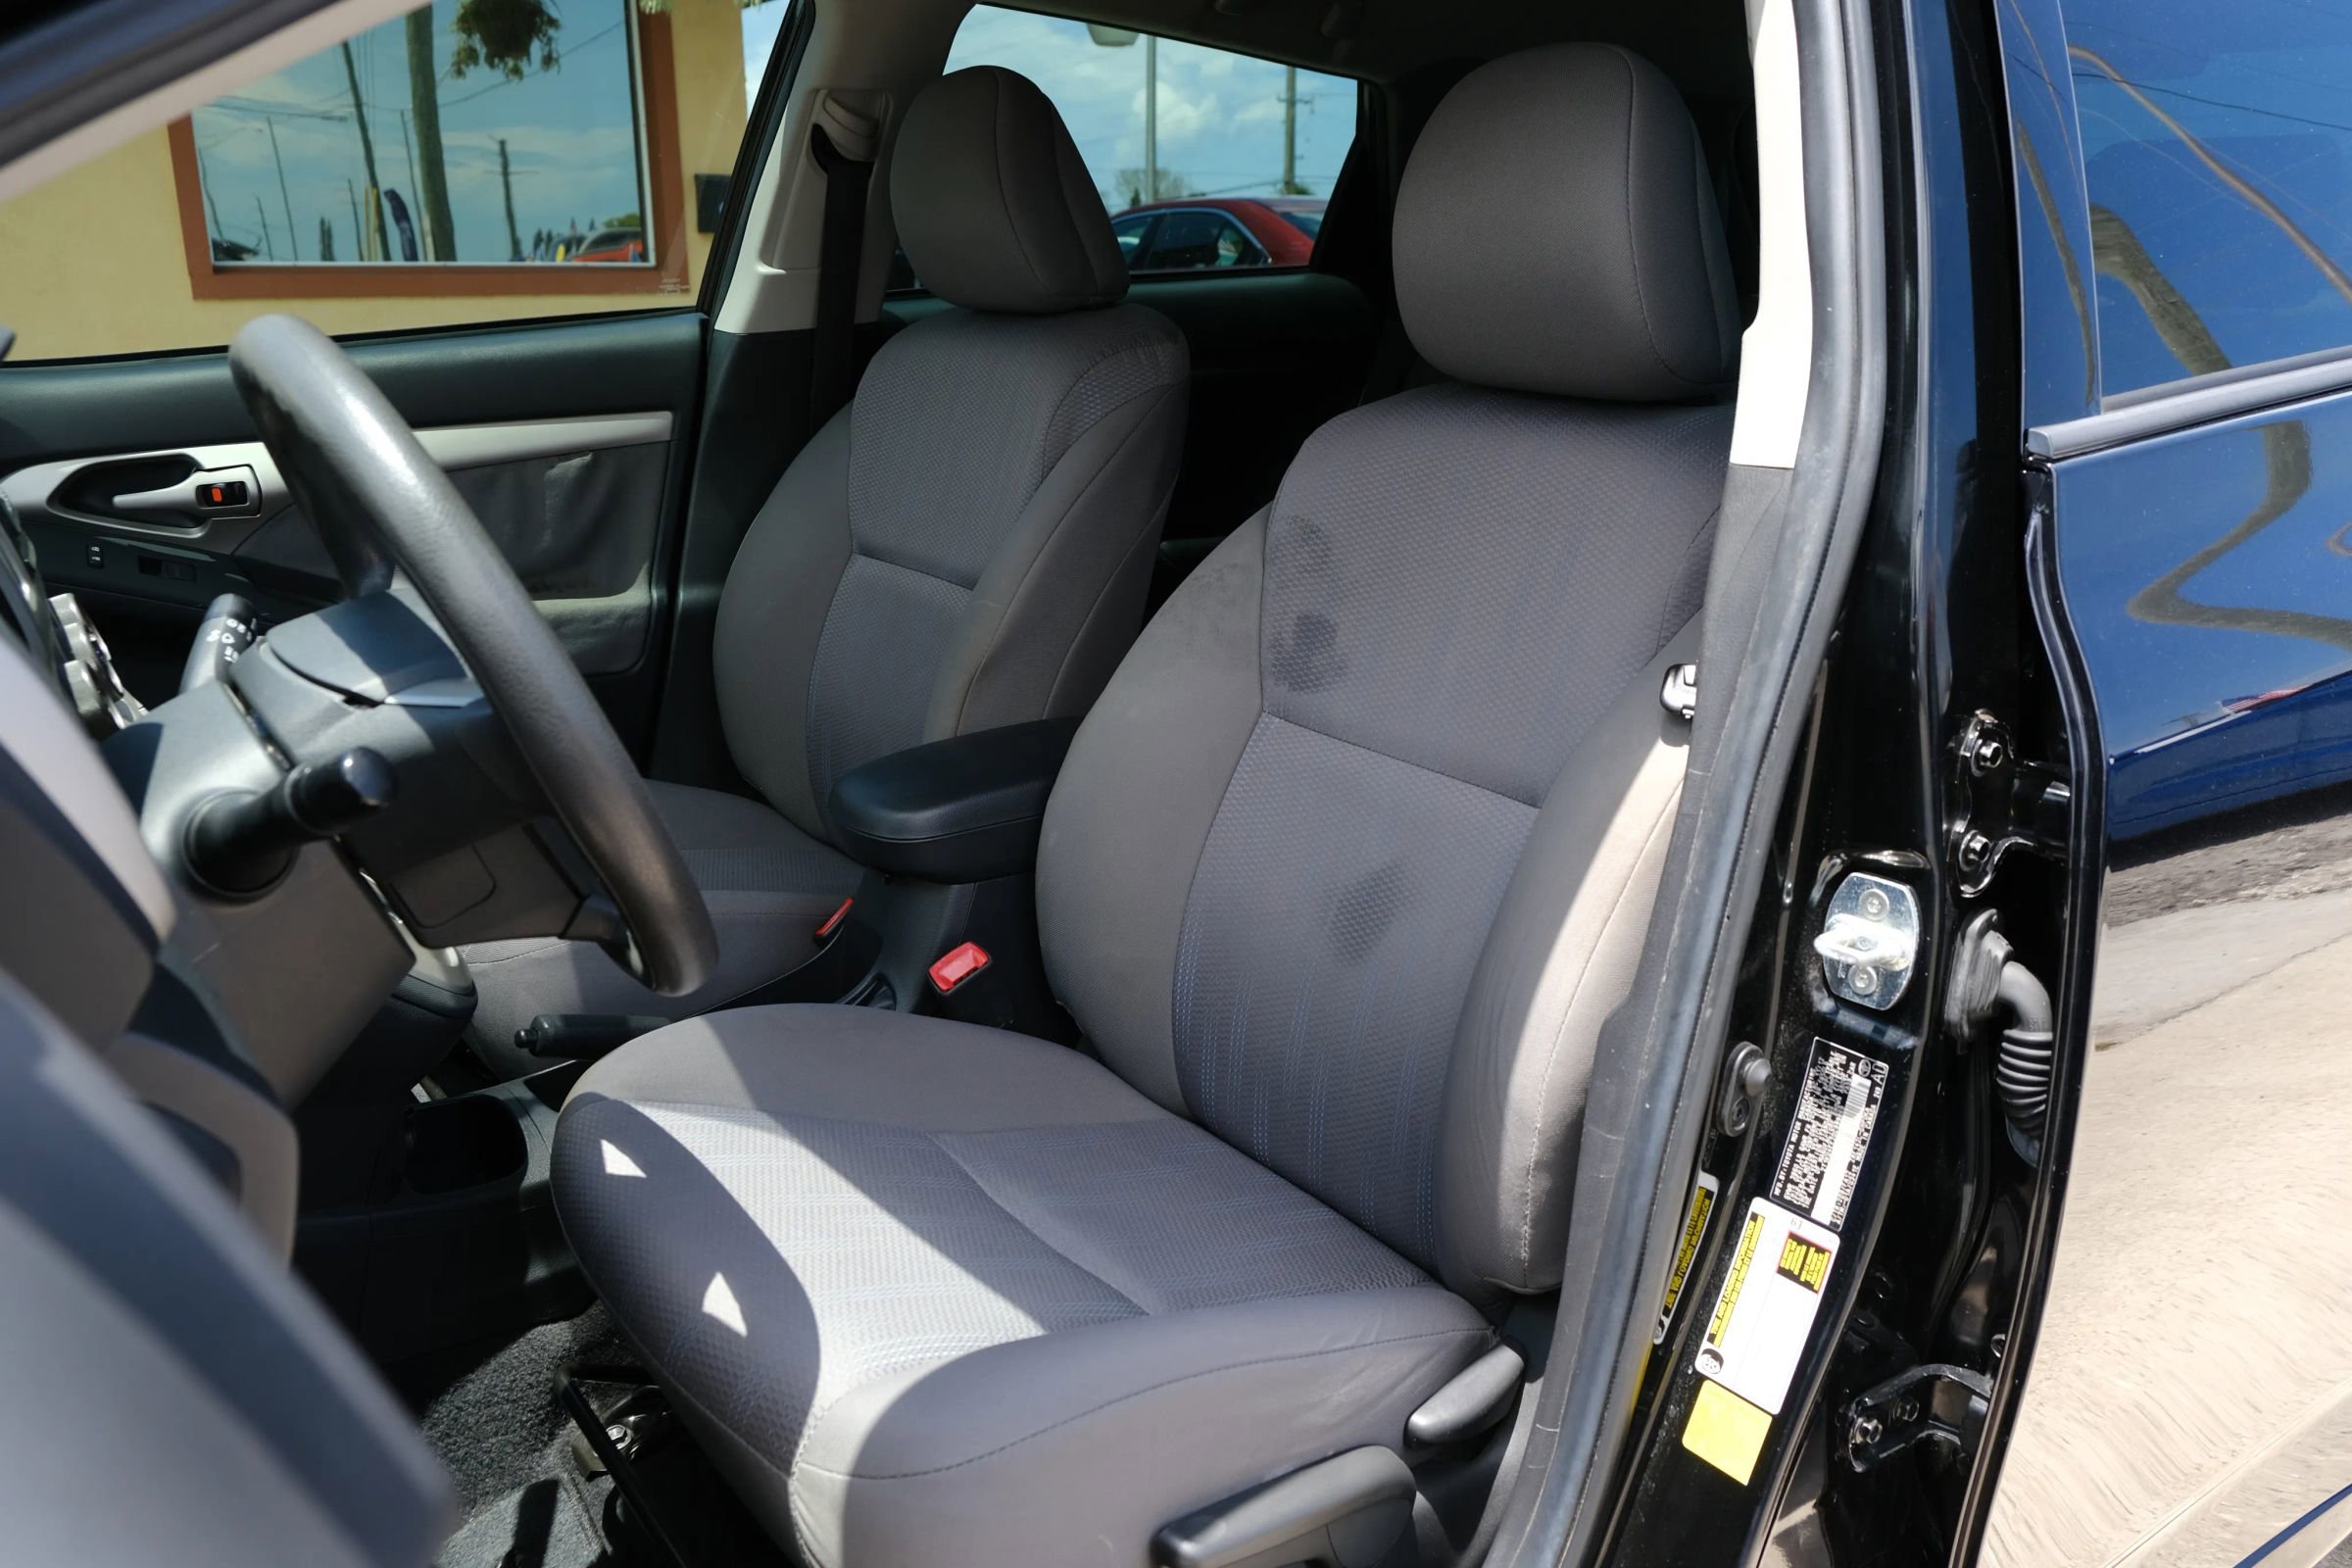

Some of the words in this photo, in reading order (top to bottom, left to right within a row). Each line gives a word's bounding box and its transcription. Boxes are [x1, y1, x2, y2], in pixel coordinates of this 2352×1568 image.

[1871, 1061, 1887, 1085] AD
[1790, 1119, 1802, 1143] MOTOR
[1715, 1299, 1728, 1319] AND
